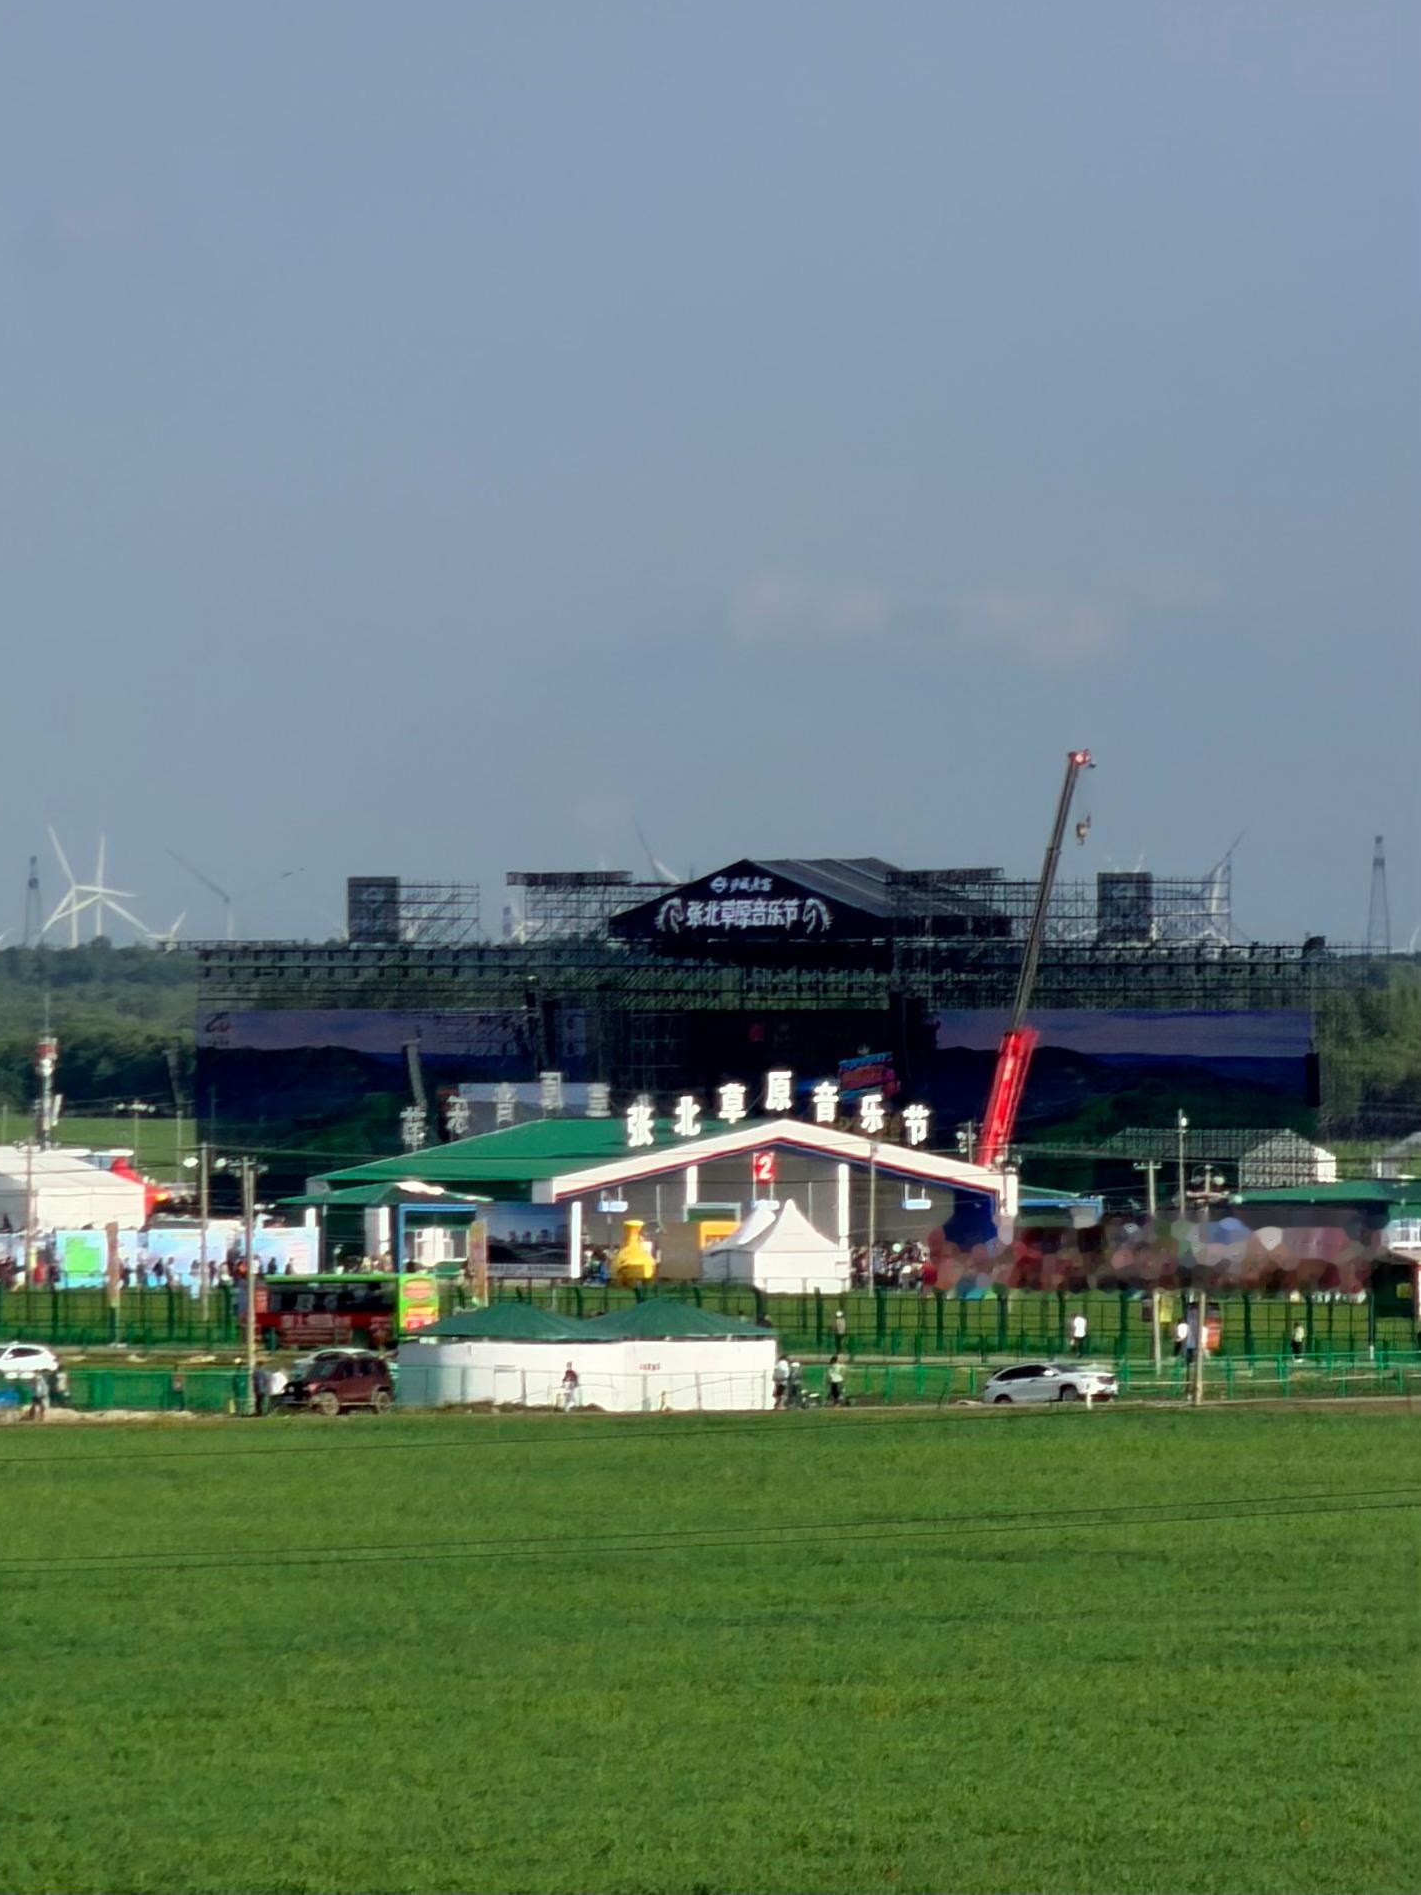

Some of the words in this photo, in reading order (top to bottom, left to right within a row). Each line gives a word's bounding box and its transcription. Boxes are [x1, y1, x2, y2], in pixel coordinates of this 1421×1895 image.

[685, 898, 800, 930] 张北草原音乐节
[626, 1071, 931, 1146] 张北草原音乐节
[758, 1156, 773, 1180] 2
